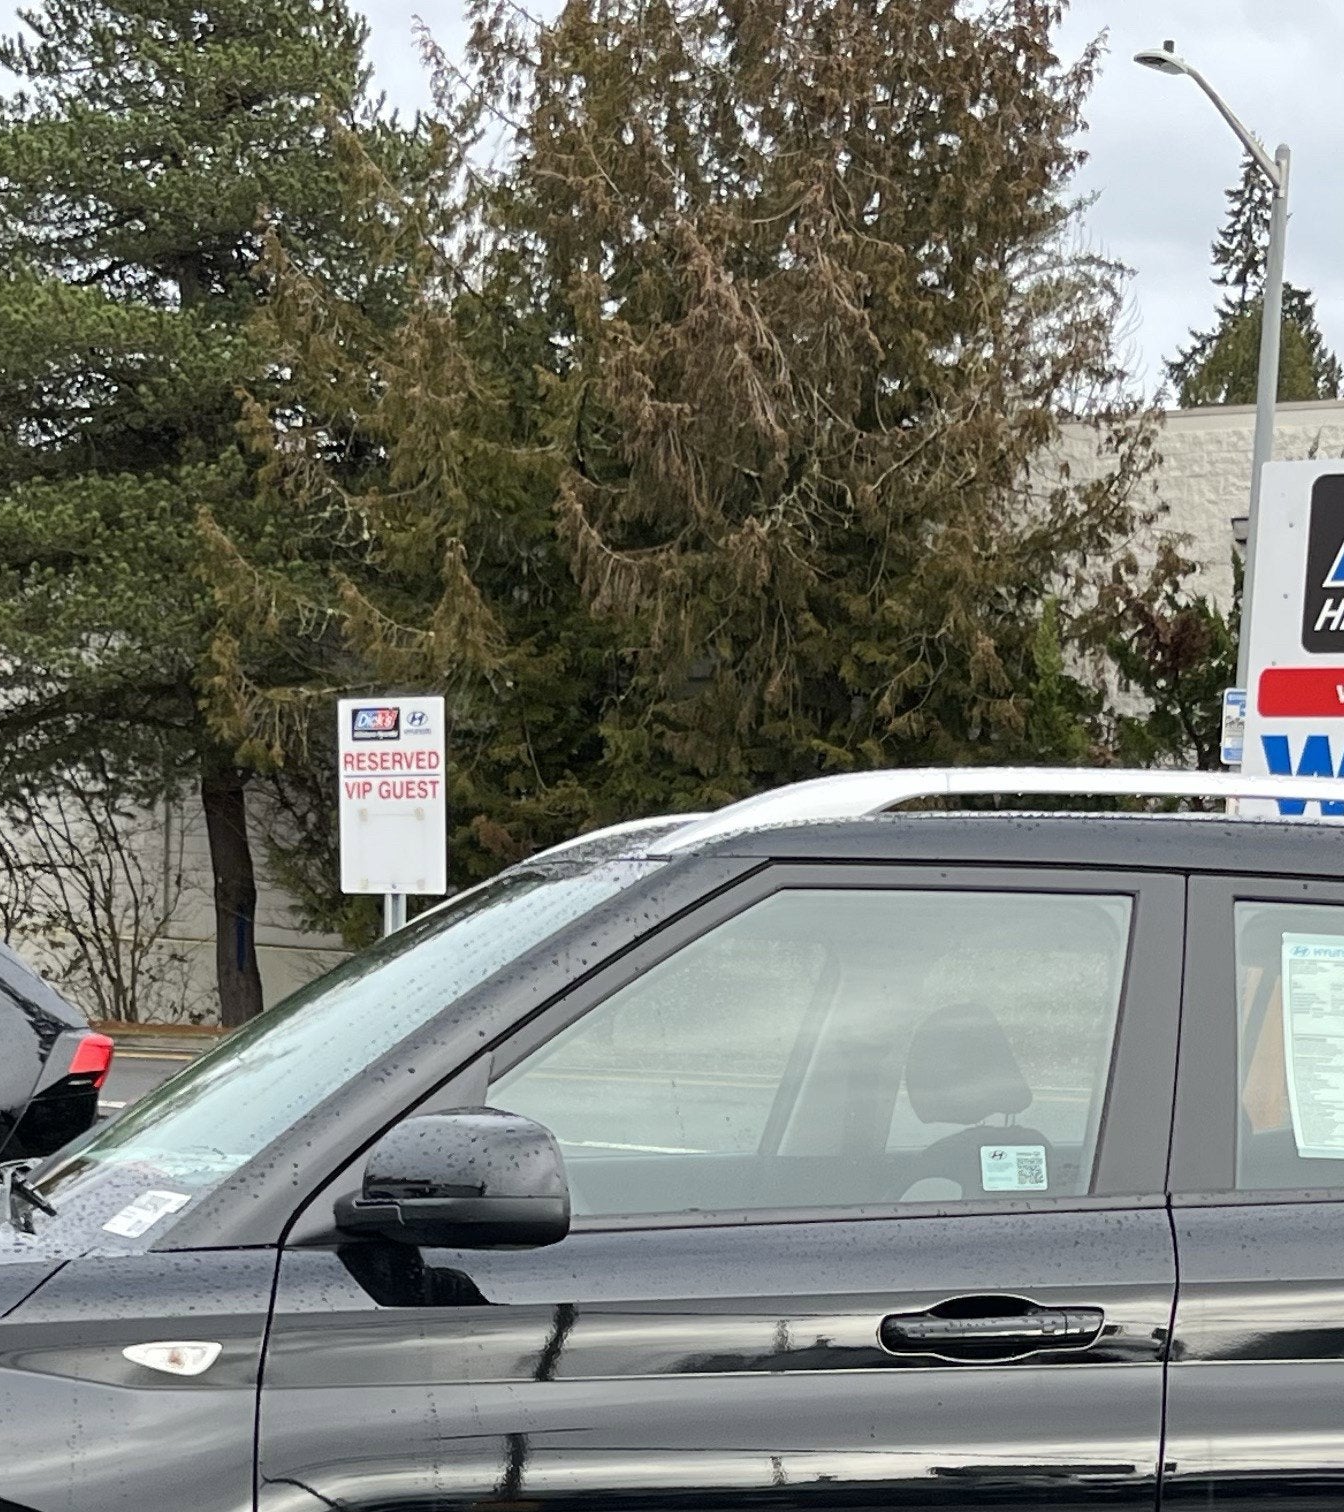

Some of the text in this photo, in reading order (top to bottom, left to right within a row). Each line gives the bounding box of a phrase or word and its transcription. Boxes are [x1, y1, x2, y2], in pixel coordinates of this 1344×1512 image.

[343, 751, 440, 771] RESERVED
[344, 780, 440, 800] VIP GUEST
